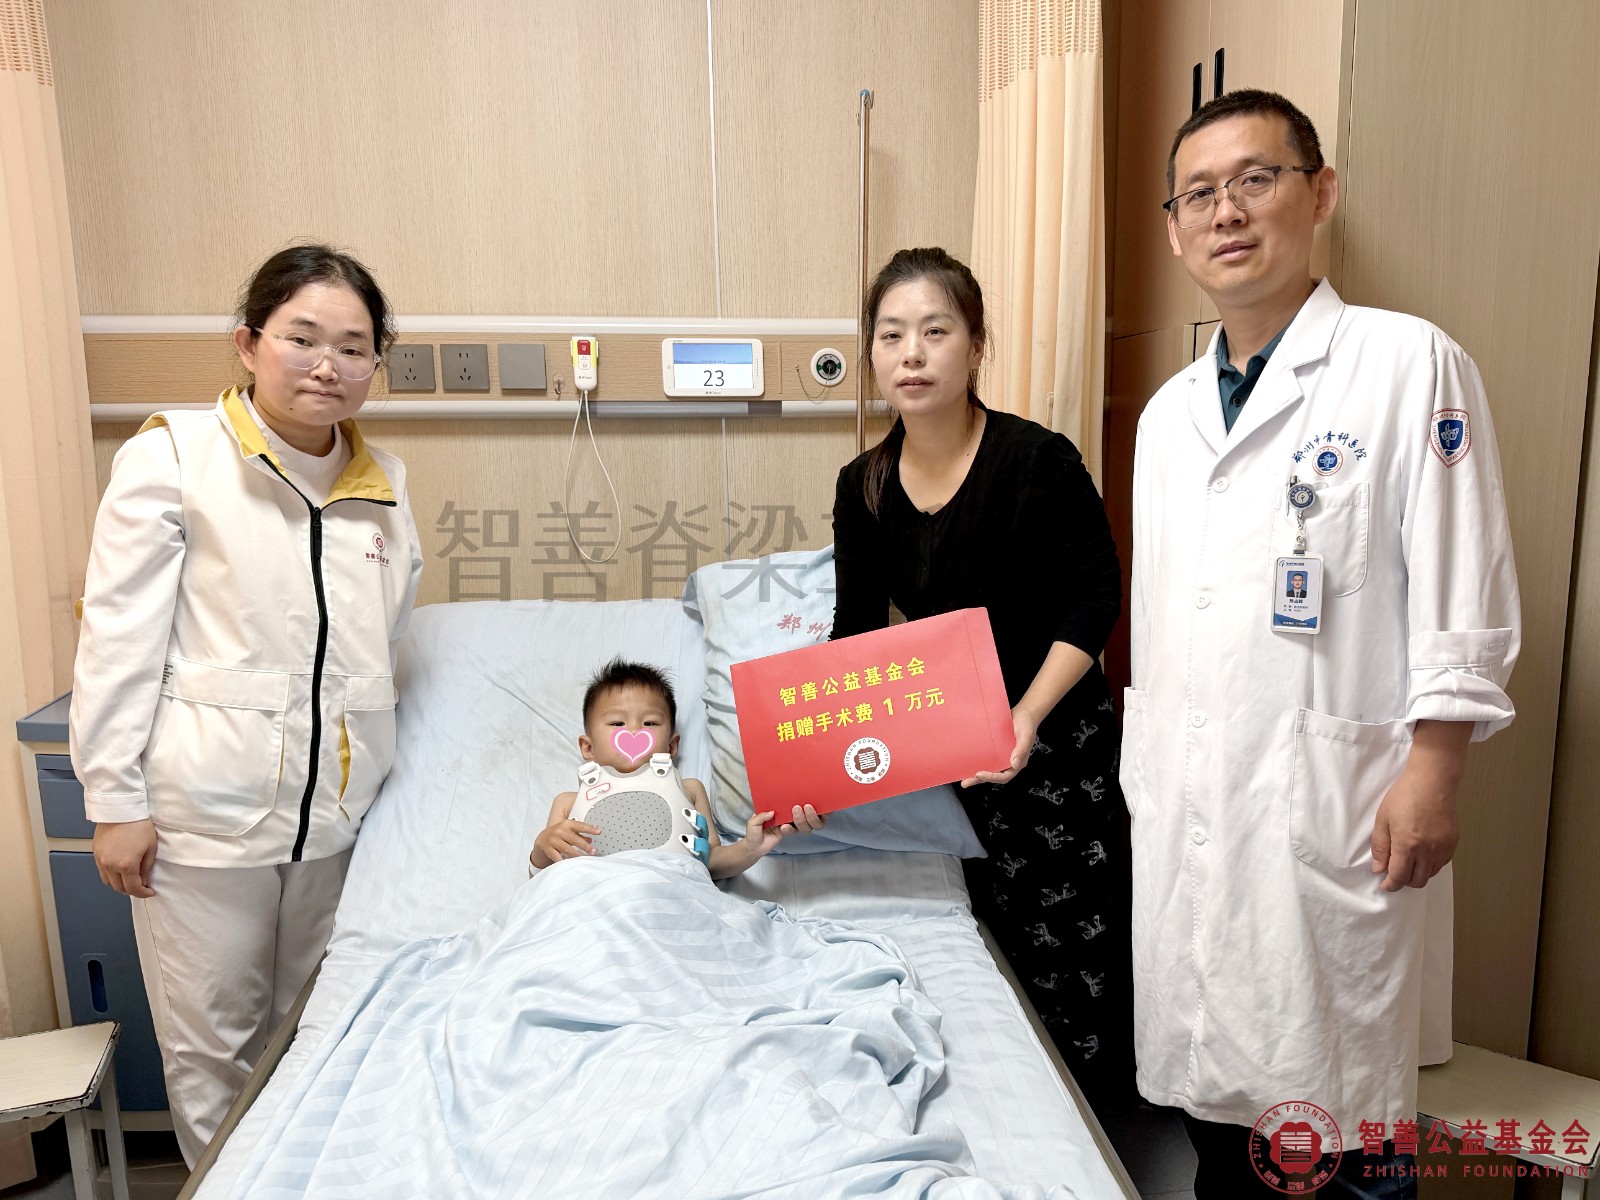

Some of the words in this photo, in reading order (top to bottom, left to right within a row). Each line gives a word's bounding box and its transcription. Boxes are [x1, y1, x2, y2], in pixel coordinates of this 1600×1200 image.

[703, 369, 725, 387] 23
[1291, 430, 1368, 464] 郑州市骨科医院
[777, 613, 831, 641] 郑州
[779, 657, 925, 707] 智善公益基金会
[776, 703, 874, 742] 捐赠手术费
[883, 698, 894, 716] 1
[904, 687, 945, 712] 万元
